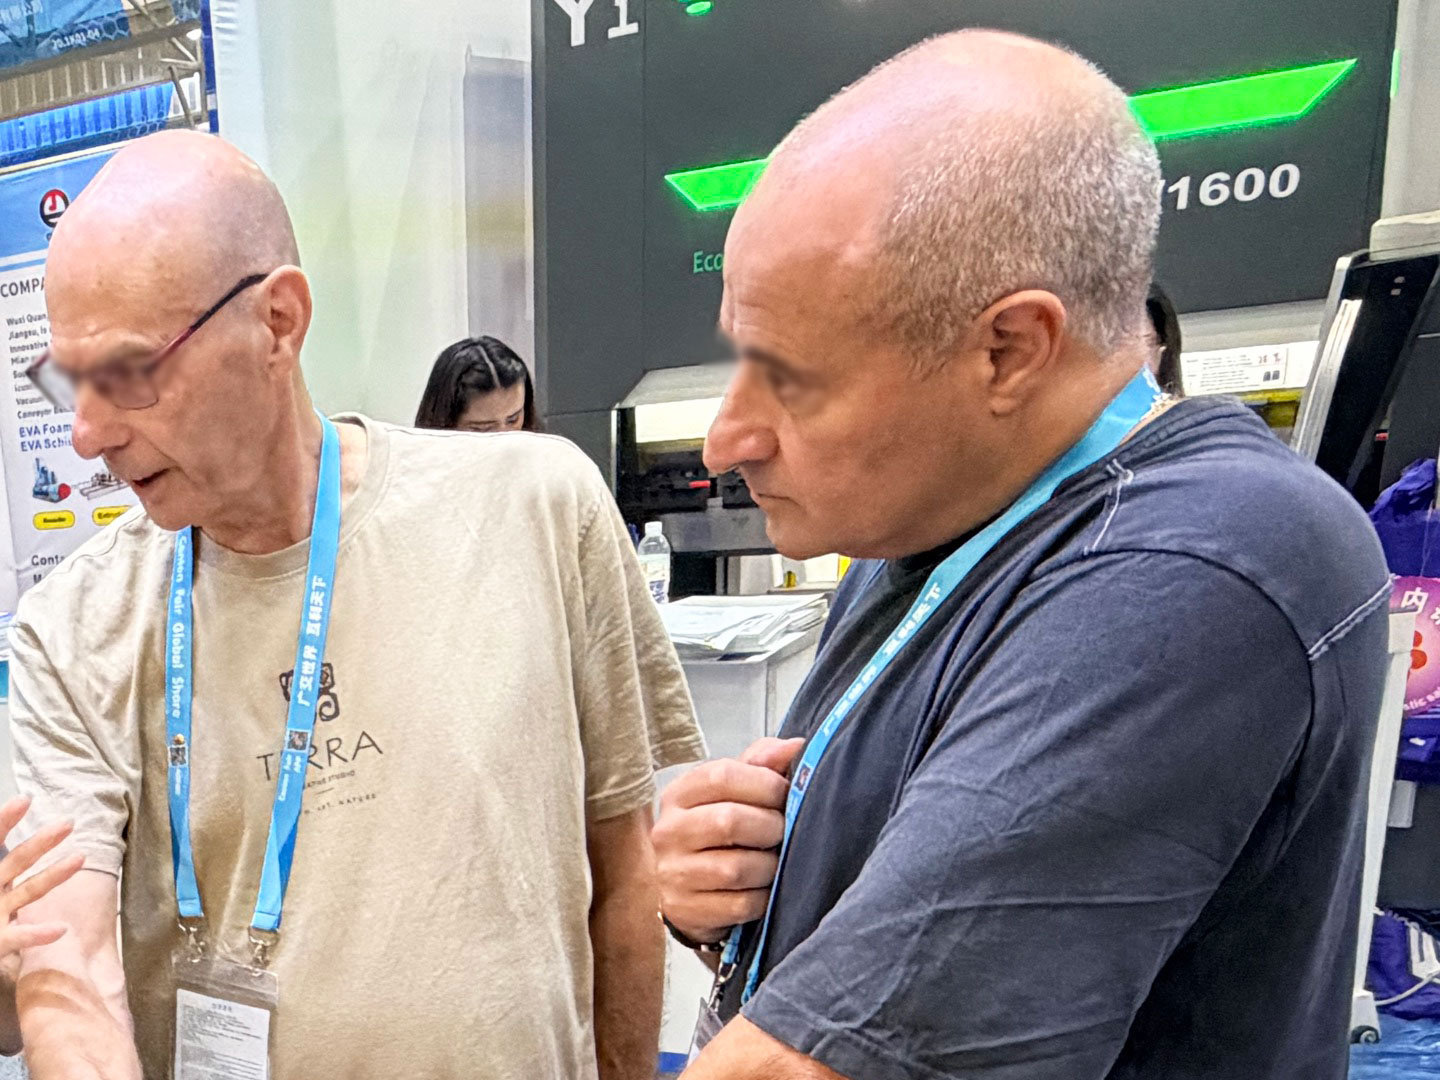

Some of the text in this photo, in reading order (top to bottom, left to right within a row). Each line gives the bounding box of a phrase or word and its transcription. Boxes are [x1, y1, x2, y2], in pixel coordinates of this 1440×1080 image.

[1159, 163, 1301, 210] 1600
[27, 313, 47, 323] Quan
[19, 425, 41, 438] EVA
[20, 440, 42, 452] EVA
[172, 622, 185, 669] Global
[172, 676, 185, 719] Share
[256, 731, 384, 782] TRRA
